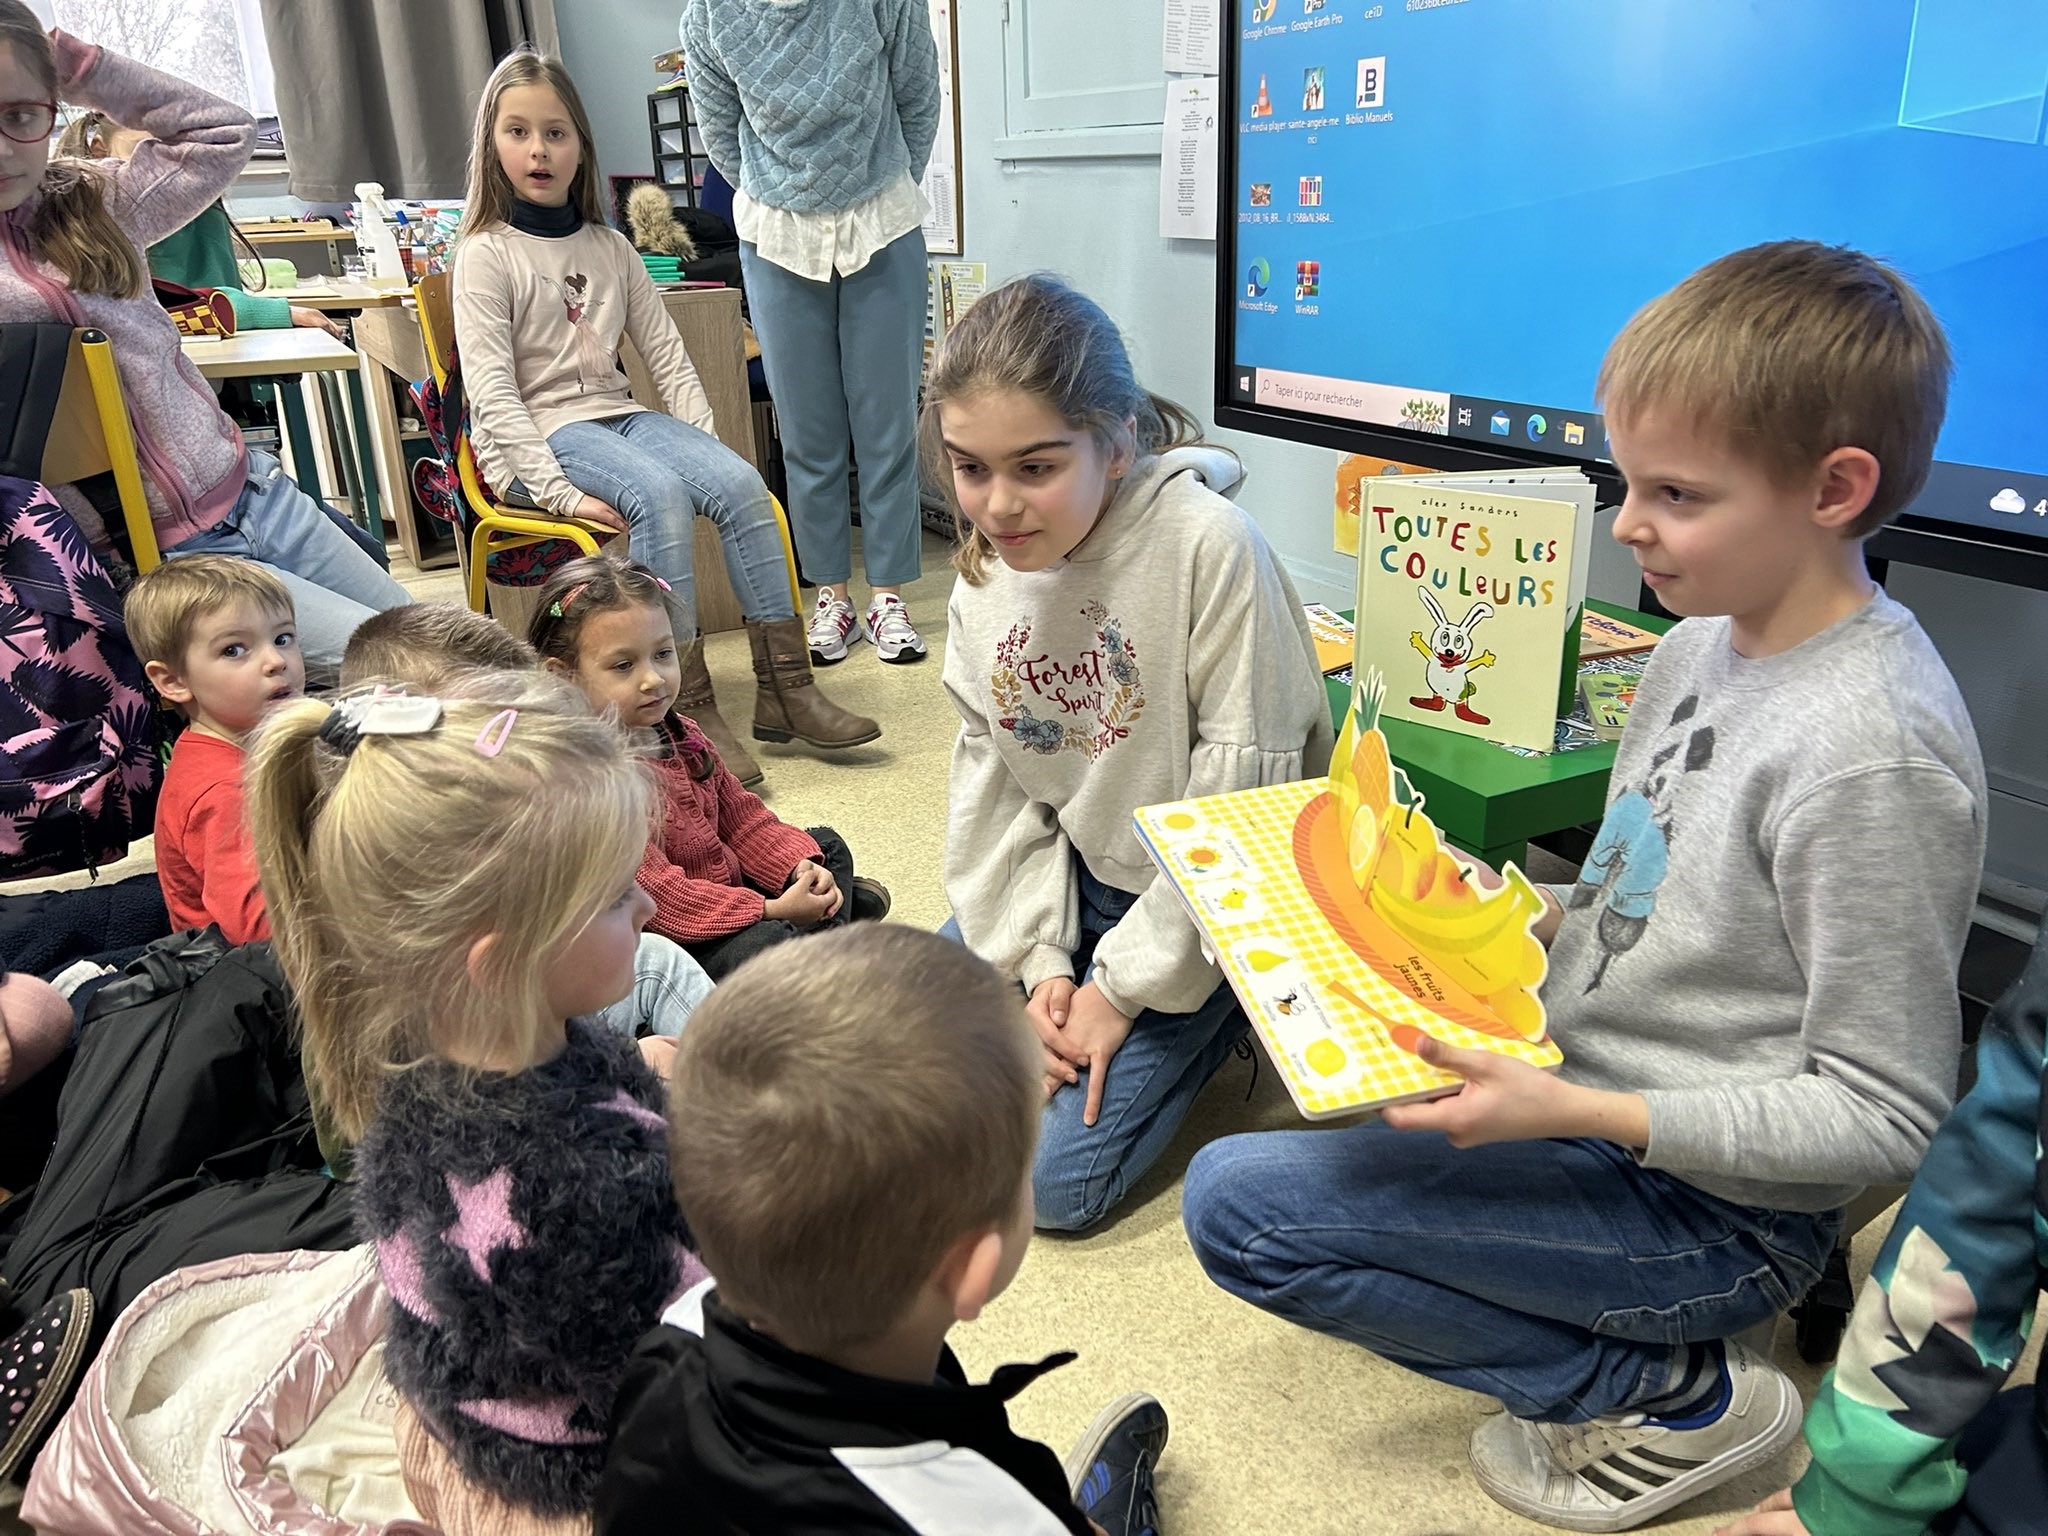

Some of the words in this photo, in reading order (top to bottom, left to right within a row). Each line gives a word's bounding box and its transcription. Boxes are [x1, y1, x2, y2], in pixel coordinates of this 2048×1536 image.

[1242, 27, 1262, 40] Google
[1264, 24, 1287, 36] Chrome
[1291, 19, 1313, 33] Google
[1314, 15, 1331, 28] Earth
[1331, 13, 1343, 25] Pro
[1365, 68, 1377, 92] B
[1240, 122, 1250, 133] VLC
[1250, 121, 1268, 132] media
[1269, 120, 1287, 133] player
[1345, 112, 1364, 125] Biblio
[1365, 109, 1393, 123] Manuels
[1239, 300, 1264, 312] Microsoft
[1264, 301, 1279, 314] Edge
[1295, 304, 1319, 316] WinRAR
[1275, 383, 1294, 399] Taper
[1294, 387, 1304, 399] ici
[1304, 391, 1322, 402] pour
[1322, 392, 1364, 408] rechercher
[1421, 498, 1447, 508] alex
[1372, 506, 1491, 557] TOUTES
[1515, 538, 1557, 563] LES
[1017, 650, 1105, 695] Forest
[1047, 687, 1105, 716] Spirit
[1393, 963, 1427, 999] jaunes
[1408, 956, 1423, 972] les
[1419, 972, 1446, 1002] fruits
